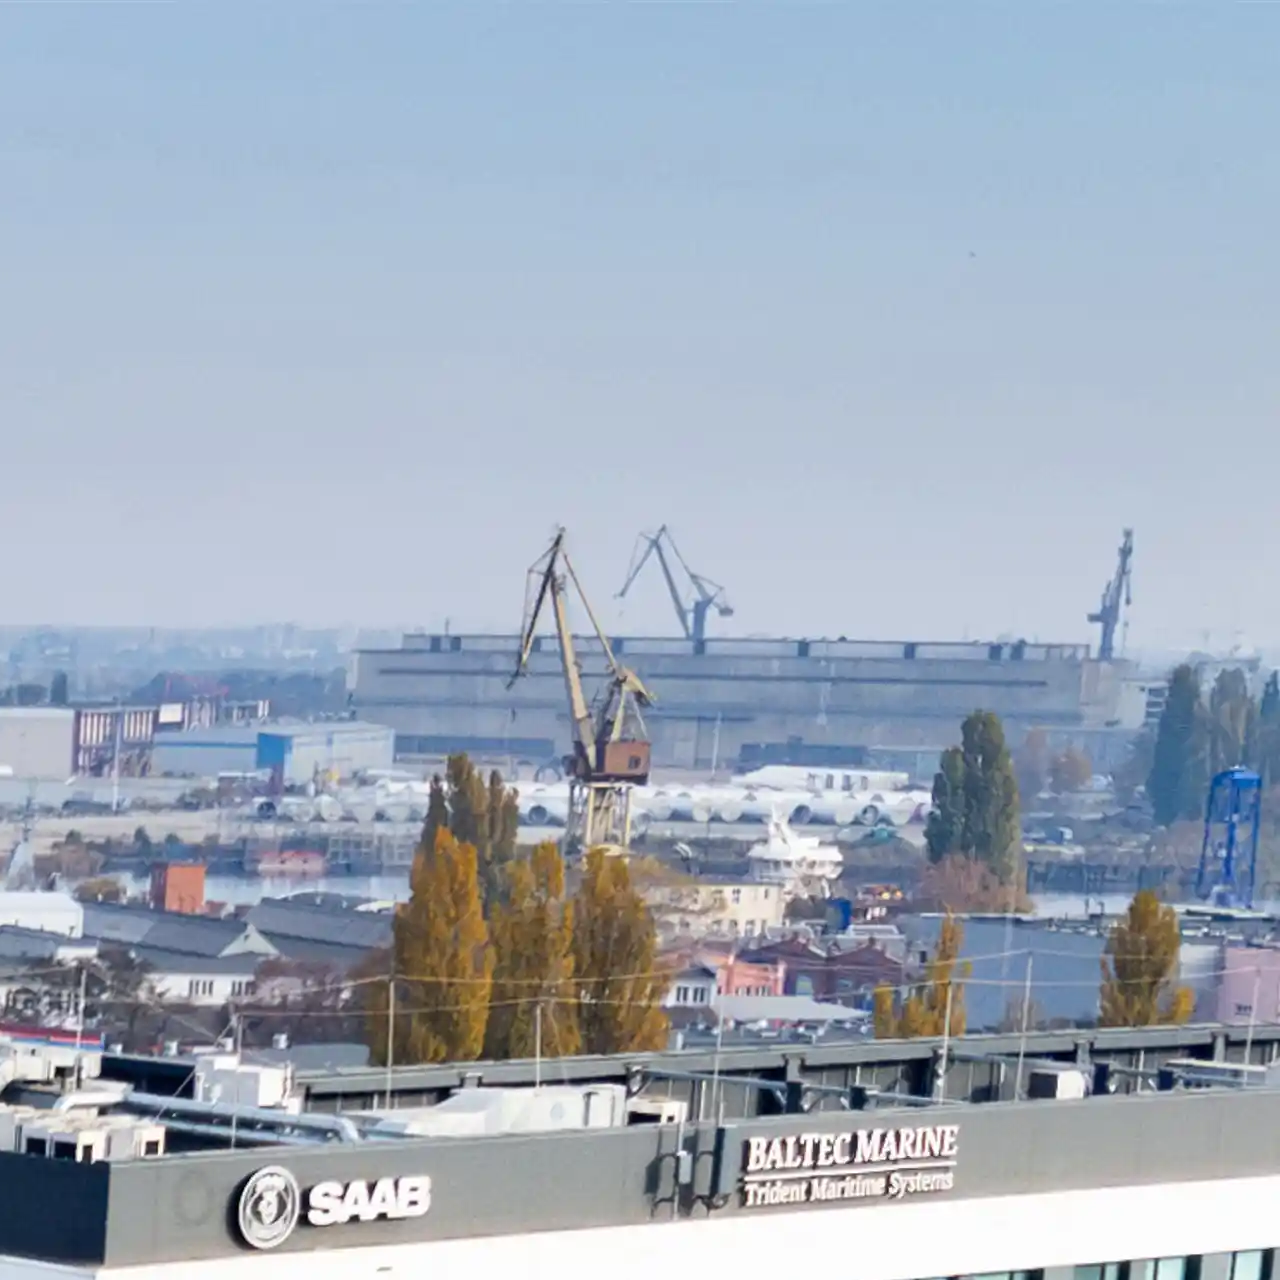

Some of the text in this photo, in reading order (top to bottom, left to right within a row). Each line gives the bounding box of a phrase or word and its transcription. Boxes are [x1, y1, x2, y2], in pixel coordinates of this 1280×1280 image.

[746, 1124, 960, 1172] BALTEC MARINE
[307, 1175, 432, 1227] SAAB
[743, 1171, 955, 1206] Trident Maritime Systems
